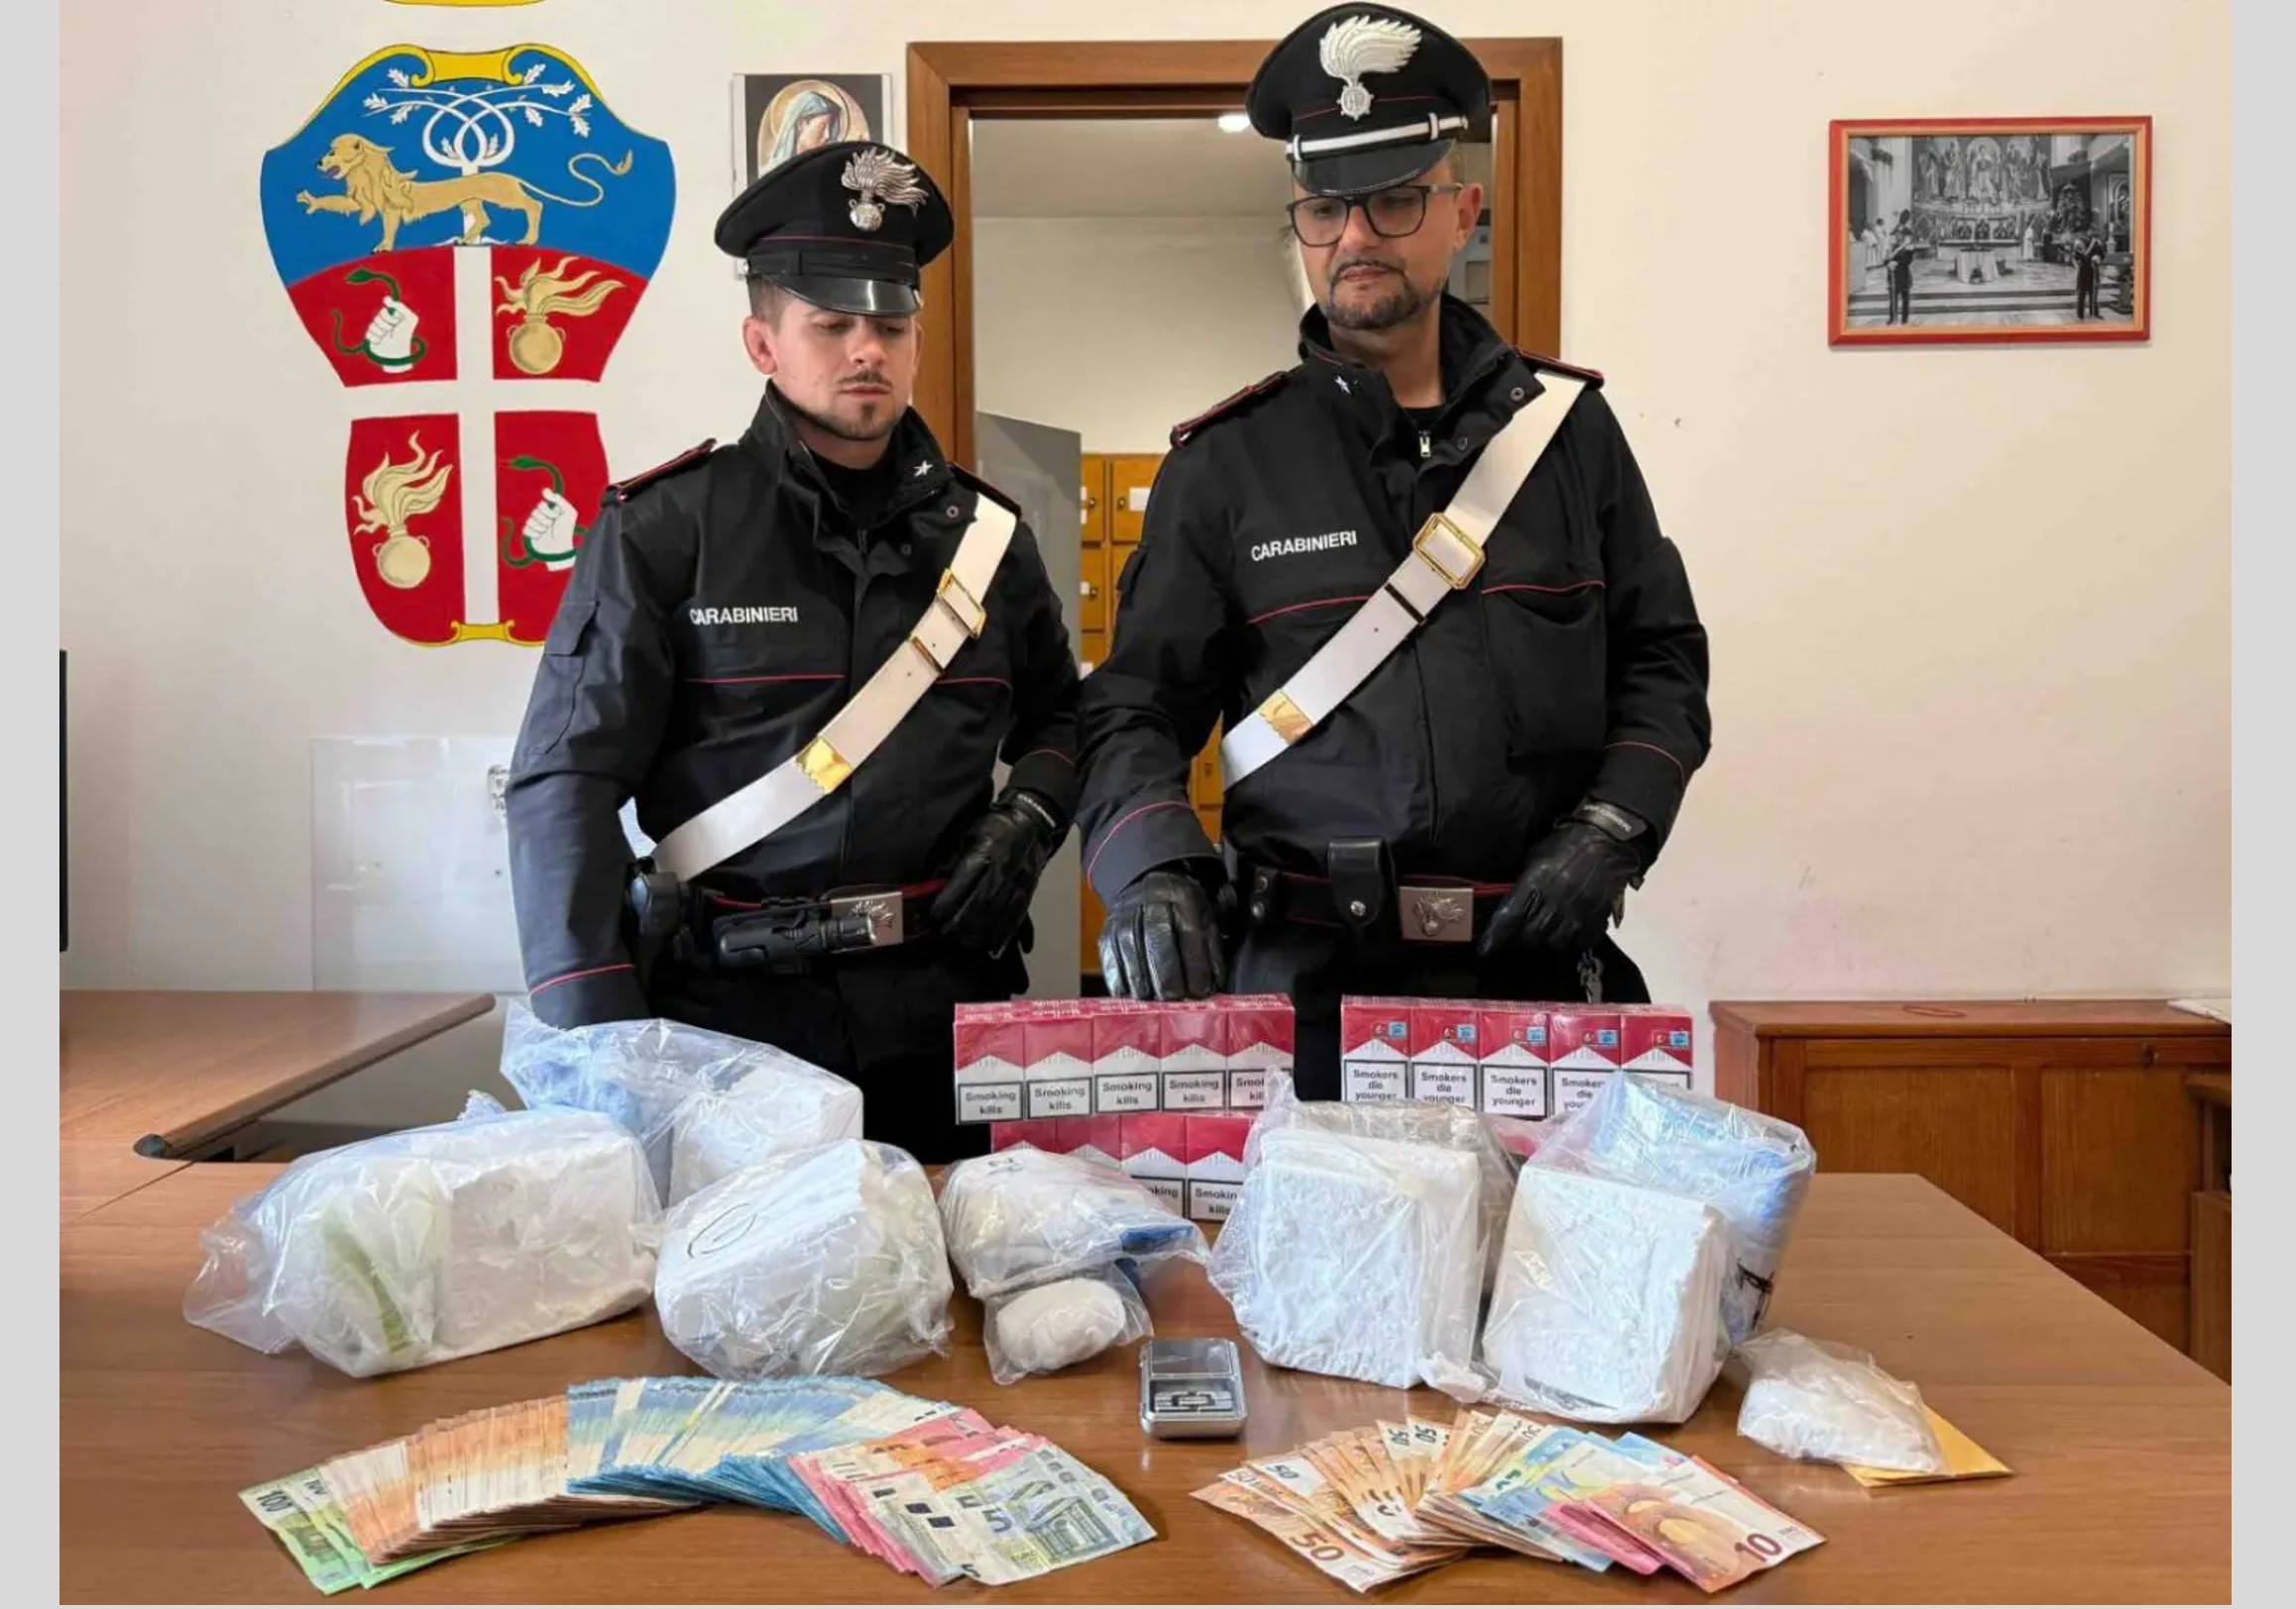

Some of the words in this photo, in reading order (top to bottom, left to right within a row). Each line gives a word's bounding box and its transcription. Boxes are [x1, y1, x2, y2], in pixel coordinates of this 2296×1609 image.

[1251, 530, 1357, 561] CARABINIERI
[690, 607, 797, 625] CARABINIERI
[1353, 1069, 1398, 1080] Smokers
[1421, 1072, 1467, 1083] Smokers
[1169, 1080, 1218, 1090] Smoking
[1368, 1080, 1384, 1090] die
[1490, 1075, 1538, 1086] Smokers
[1034, 1087, 1086, 1098] Smoking
[1102, 1082, 1152, 1092] Smoking
[1436, 1083, 1452, 1092] die
[1505, 1086, 1522, 1095] die
[966, 1092, 1016, 1102] Smoking
[1116, 1094, 1139, 1105] kills
[1183, 1093, 1205, 1102] kills
[1576, 1090, 1593, 1098] die
[1049, 1100, 1072, 1110] kills
[1492, 1096, 1536, 1107] younger
[979, 1105, 1002, 1114] kills
[1195, 1188, 1237, 1201] Smokin
[1415, 1425, 1436, 1443] 50
[1265, 1464, 1300, 1479] 50
[256, 1489, 293, 1513] 100
[981, 1507, 1012, 1533] 5
[1290, 1532, 1345, 1561] 50
[1734, 1533, 1782, 1562] 10
